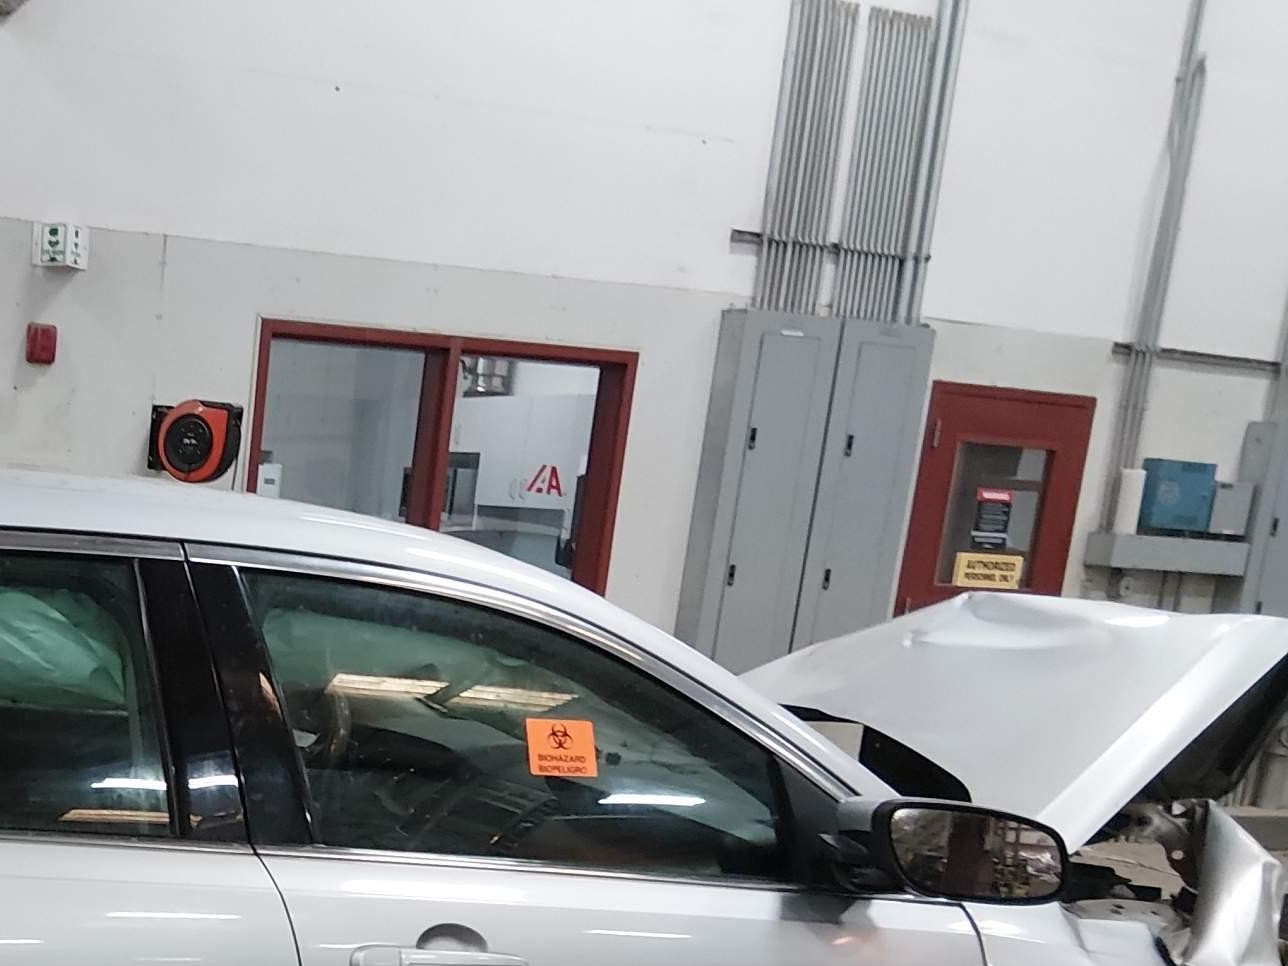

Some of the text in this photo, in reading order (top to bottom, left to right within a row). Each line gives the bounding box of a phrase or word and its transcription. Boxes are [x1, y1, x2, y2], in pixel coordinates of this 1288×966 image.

[966, 560, 1016, 572] AUTHORIZED
[537, 753, 586, 763] BIOHAZARD
[538, 765, 588, 774] BIOPELIGRO
